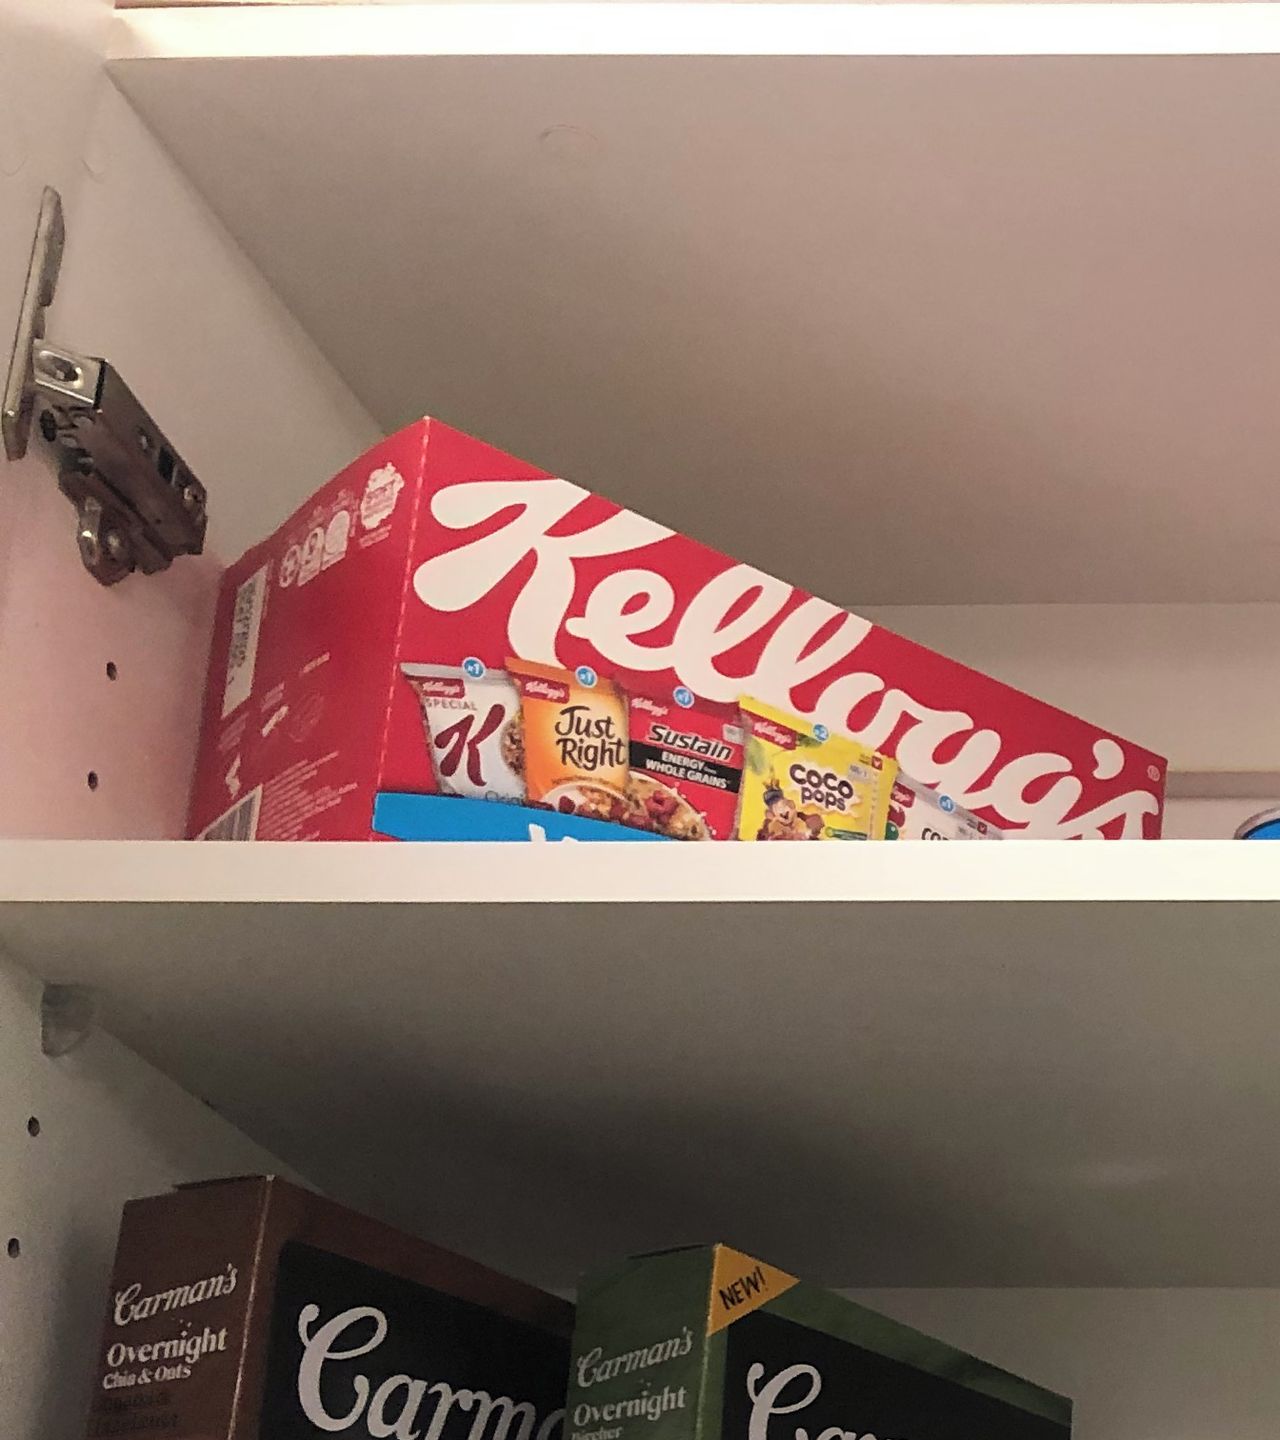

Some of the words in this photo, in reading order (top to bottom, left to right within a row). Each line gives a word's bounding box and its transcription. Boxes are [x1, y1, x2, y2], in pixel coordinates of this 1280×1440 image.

[413, 478, 1158, 839] Kellogg's
[425, 698, 477, 711] SPECIAL
[555, 706, 616, 739] Just
[434, 703, 506, 786] K
[556, 737, 627, 771] Right
[650, 725, 733, 761] Sustain
[661, 752, 705, 771] ENERGY
[646, 759, 686, 778] WHOLE
[687, 770, 728, 789] GRAINS
[114, 1263, 238, 1326] Carman's
[719, 1266, 767, 1310] NEW!
[107, 1326, 228, 1367] Overnight
[577, 1326, 694, 1388] Carman's
[103, 1369, 136, 1389] Chia
[137, 1368, 152, 1385] &
[154, 1363, 192, 1381] Oats
[574, 1386, 687, 1426] Overnight
